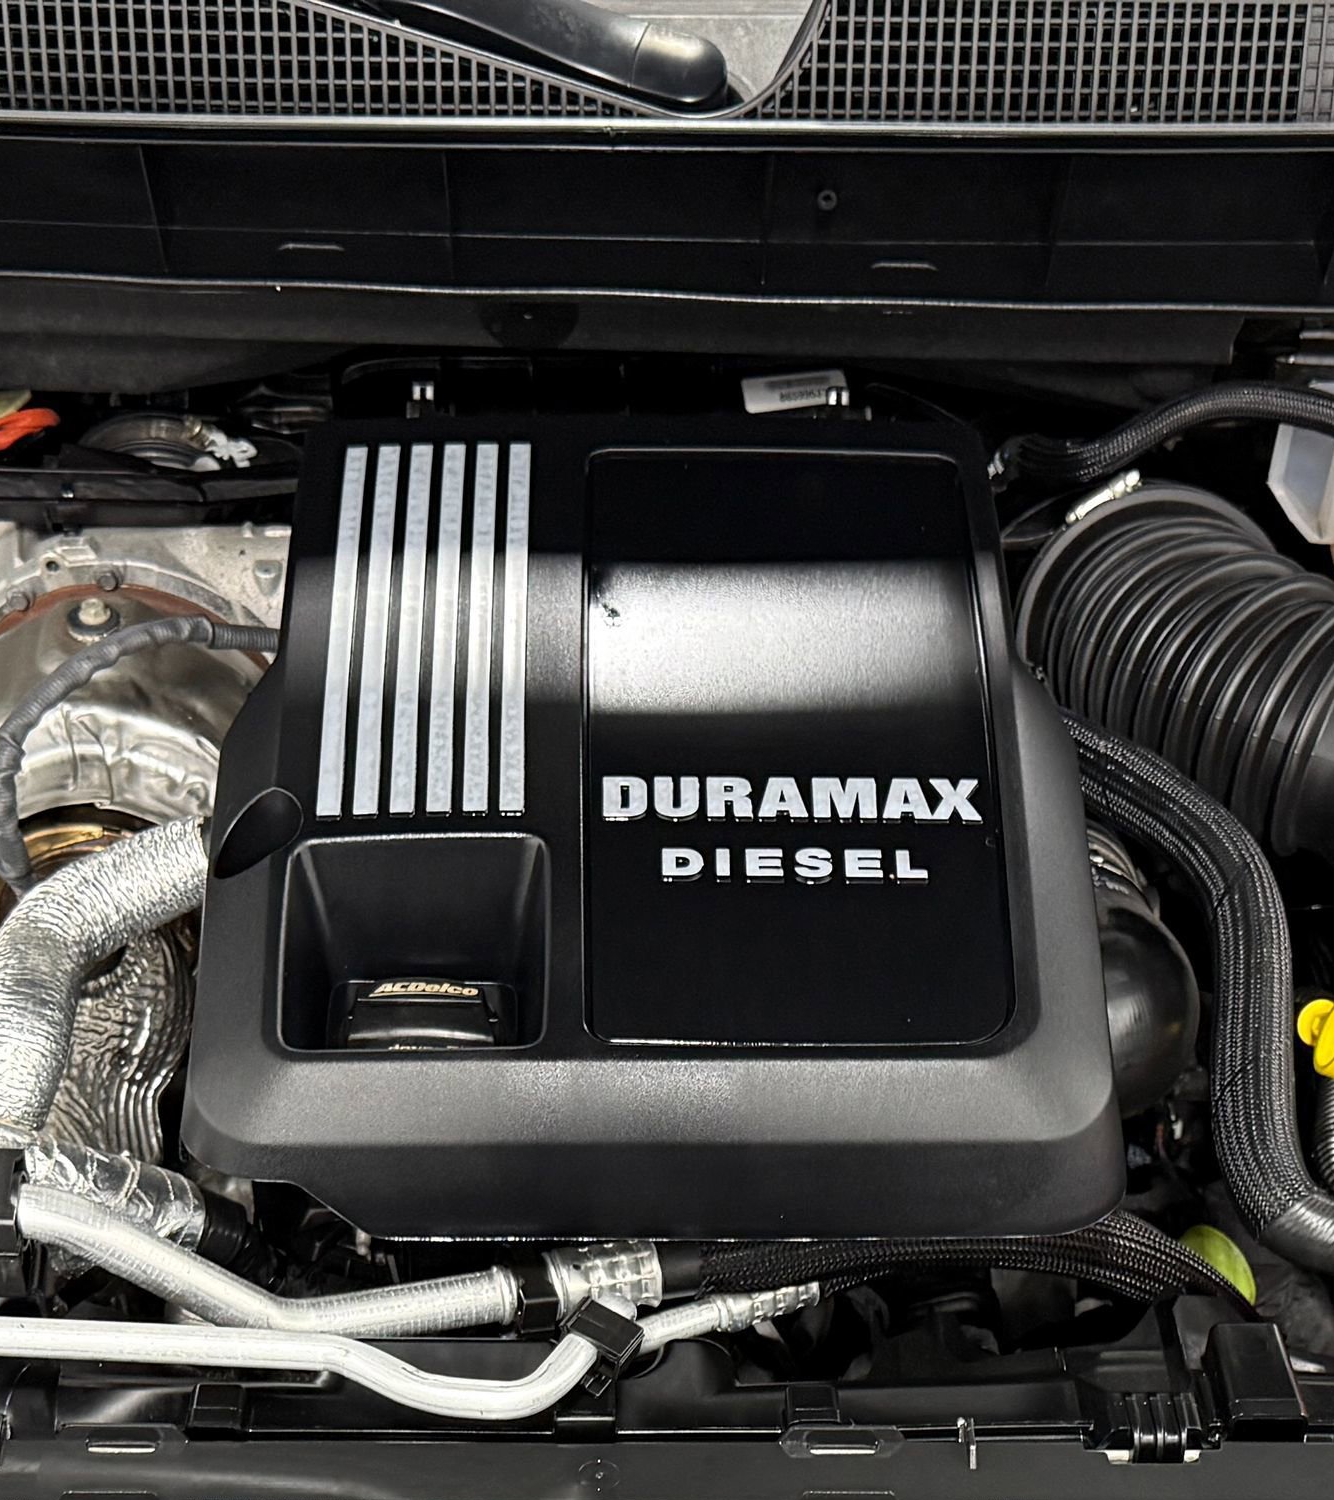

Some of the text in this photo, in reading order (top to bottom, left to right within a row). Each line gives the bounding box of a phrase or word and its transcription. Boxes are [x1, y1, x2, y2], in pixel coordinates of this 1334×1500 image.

[602, 776, 983, 824] DURAMAX
[661, 847, 929, 884] DIESEL
[370, 981, 479, 997] ACDelco
